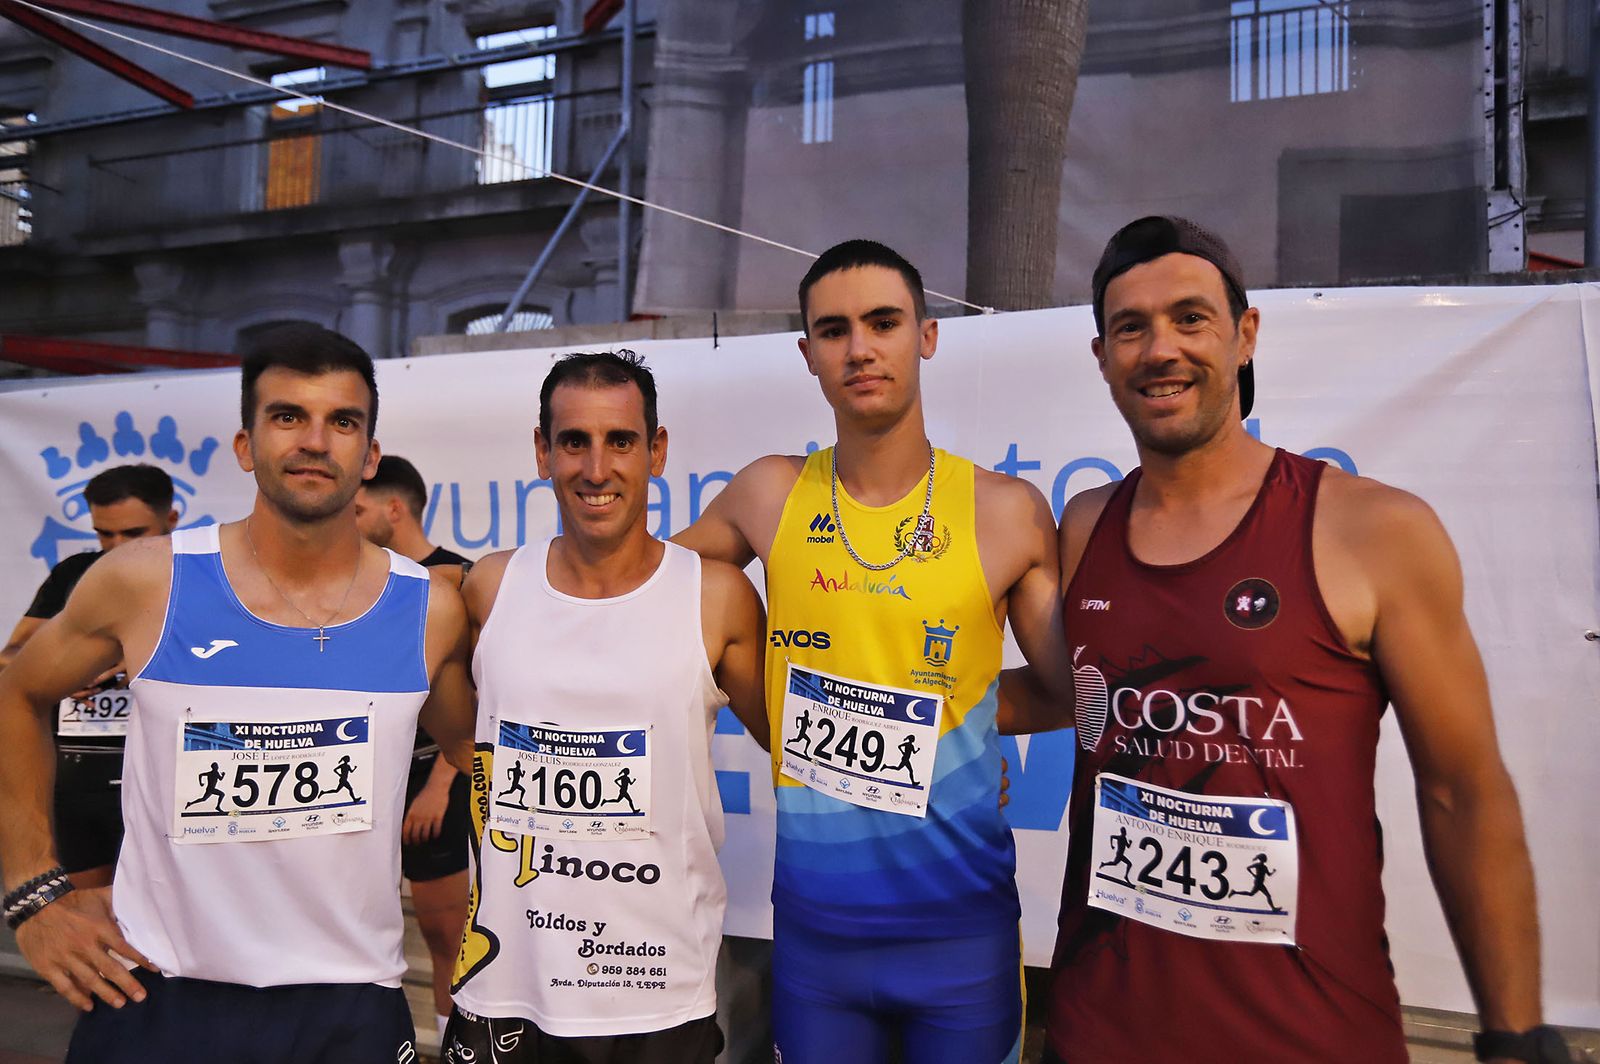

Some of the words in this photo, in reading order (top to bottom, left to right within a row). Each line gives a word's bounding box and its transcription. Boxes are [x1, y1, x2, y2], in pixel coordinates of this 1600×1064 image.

[807, 535, 835, 544] mobel
[810, 567, 912, 601] Andalucía
[823, 679, 833, 691] XI
[835, 683, 895, 705] NOCTURNA
[812, 702, 851, 722] ENRIQUE
[827, 695, 840, 707] DE
[842, 700, 885, 717] HUELVA
[1112, 687, 1304, 741] COSTA
[235, 725, 249, 735] XI
[252, 722, 324, 735] NOCTURNA
[532, 729, 542, 739] XI
[545, 731, 605, 744] NOCTURNA
[244, 739, 261, 749] DE
[264, 737, 314, 749] HUELVA
[538, 743, 551, 753] DE
[554, 746, 597, 757] HUELVA
[813, 717, 885, 774] 249
[1114, 735, 1195, 761] SALUD
[1203, 742, 1304, 768] DENTAL
[262, 752, 270, 760] E
[540, 755, 561, 766] LUIS
[231, 761, 319, 807] 578
[531, 766, 602, 810] 160
[1141, 790, 1153, 804] XI
[1156, 795, 1234, 819] NOCTURNA
[184, 826, 217, 835] Huelva
[1115, 814, 1165, 836] ANTONIO
[1167, 829, 1225, 848] ENRIQUE
[1149, 809, 1165, 824] DE
[1168, 814, 1223, 834] HUELVA
[1137, 836, 1230, 901] 243
[1096, 889, 1126, 905] Huelva
[526, 909, 587, 932] Toldos
[592, 921, 607, 937] y
[577, 938, 667, 958] Bordados
[601, 965, 623, 975] 959
[625, 966, 646, 976] 384
[649, 967, 667, 977] 651
[550, 978, 575, 987] Avda.
[577, 978, 621, 989] Diputación
[636, 980, 666, 989] LEPE
